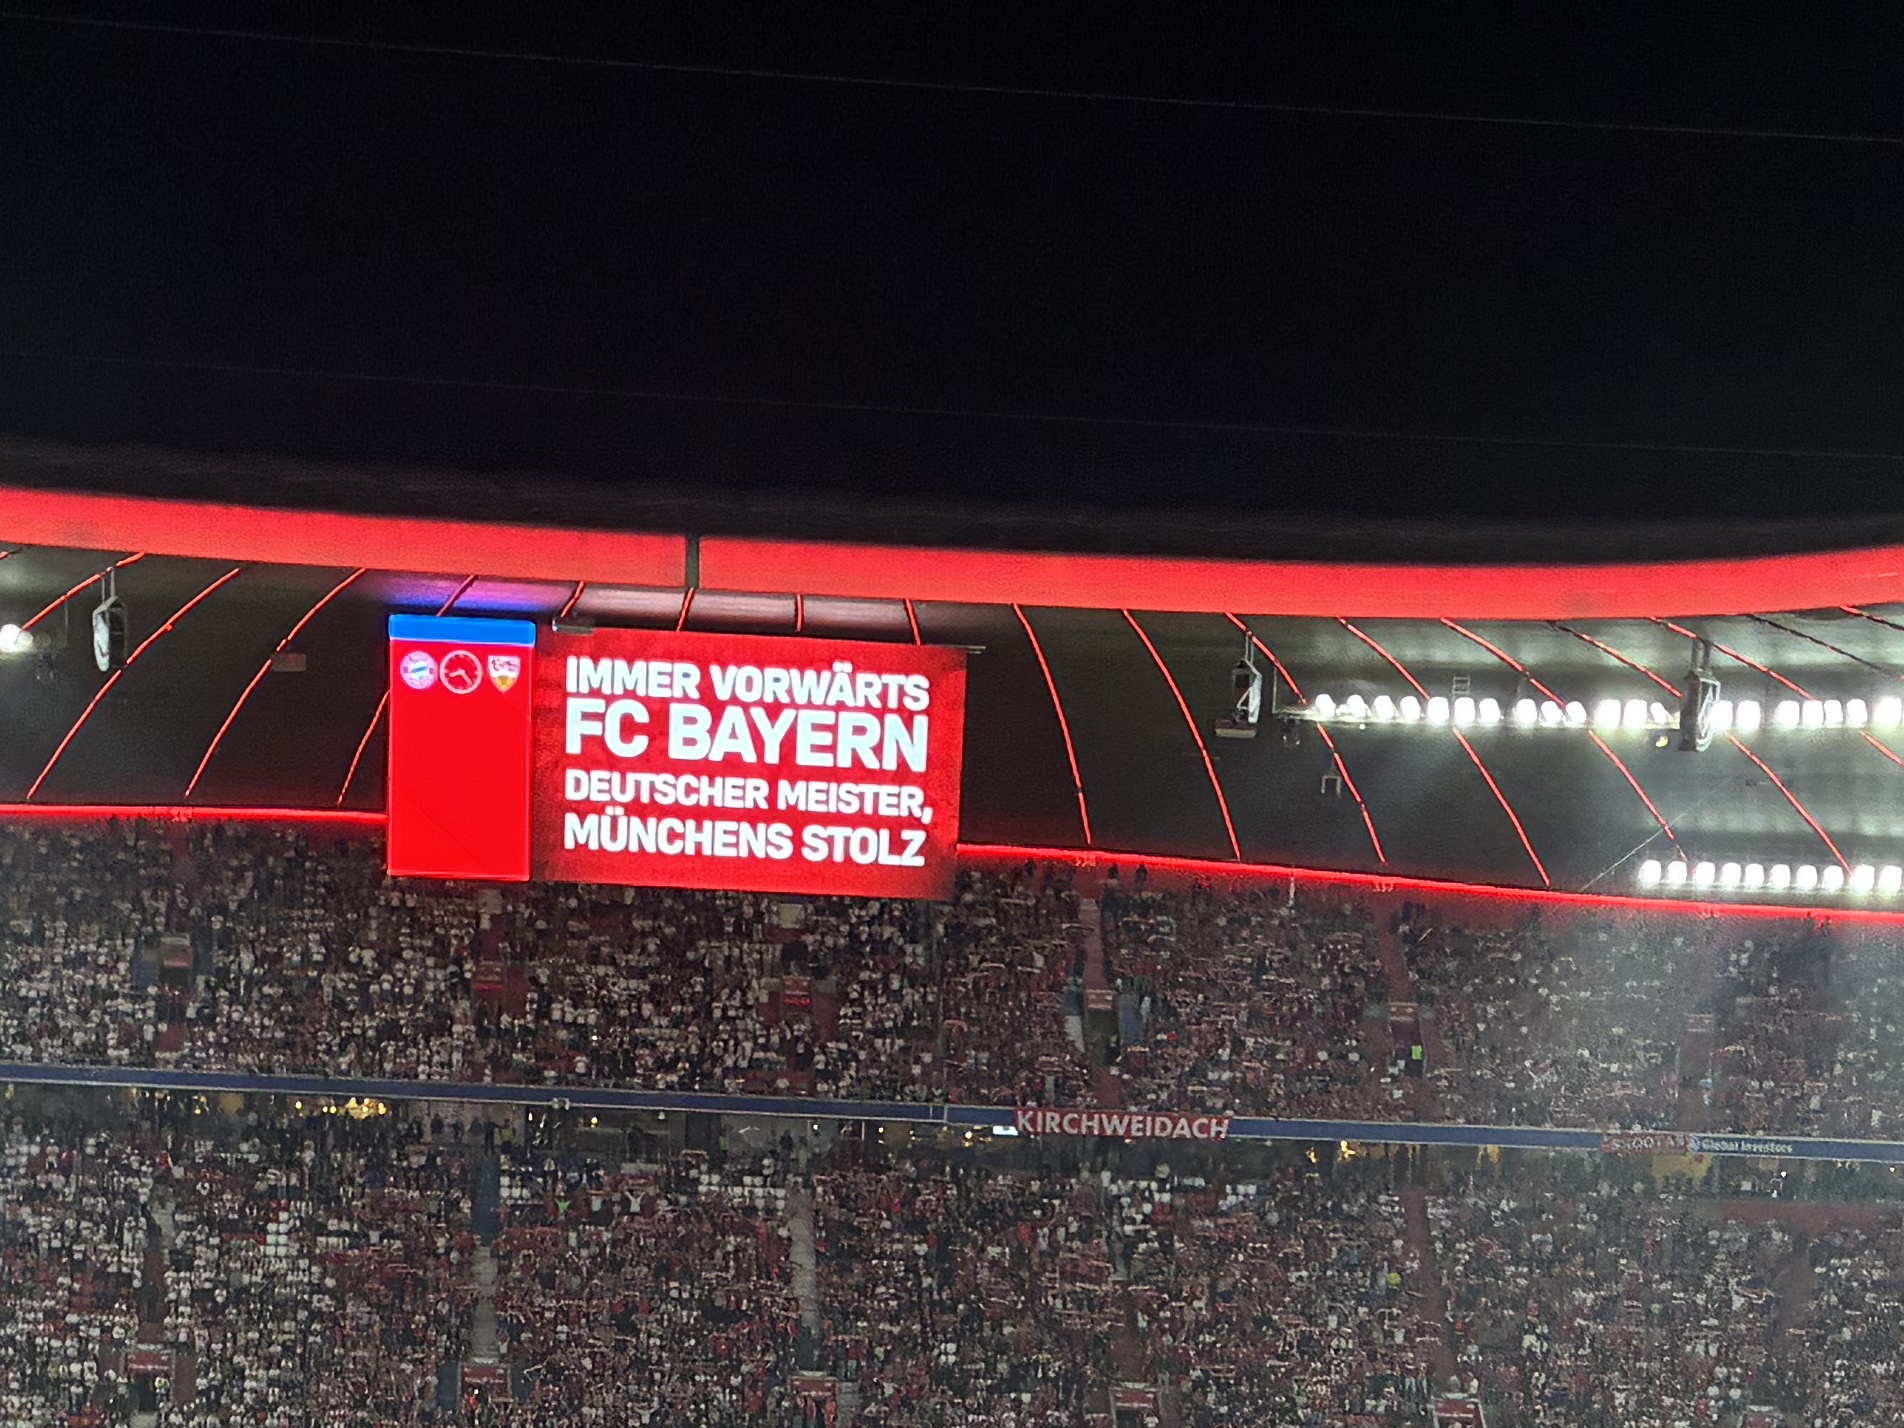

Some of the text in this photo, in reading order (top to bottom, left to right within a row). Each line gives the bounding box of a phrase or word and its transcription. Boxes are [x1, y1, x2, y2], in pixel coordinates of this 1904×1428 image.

[567, 656, 929, 711] IMMER VORWÄRTS
[566, 700, 928, 772] FC BAYERN
[565, 769, 933, 824] DEUTSCHER MEISTER,
[564, 807, 926, 867] MÜNCHENS STOLZ
[1016, 1109, 1229, 1138] KIRCHWEIDACH
